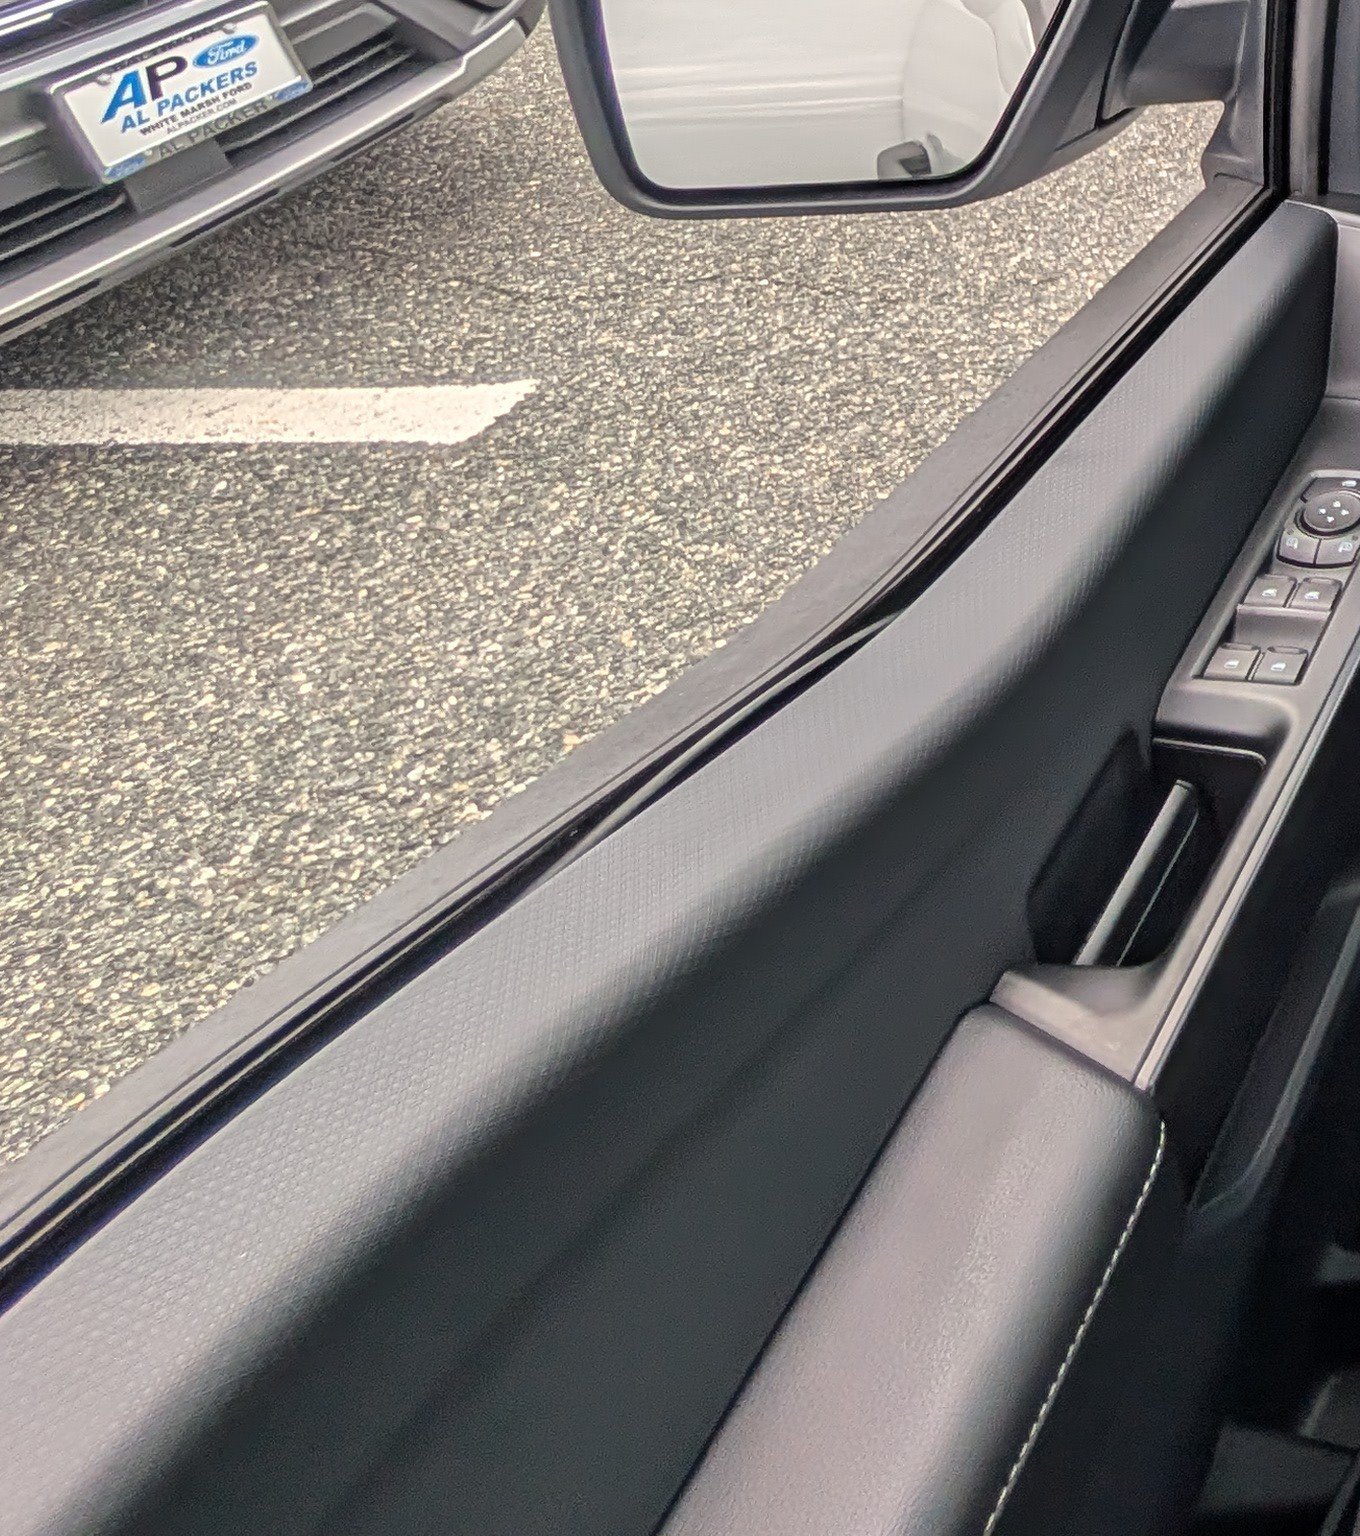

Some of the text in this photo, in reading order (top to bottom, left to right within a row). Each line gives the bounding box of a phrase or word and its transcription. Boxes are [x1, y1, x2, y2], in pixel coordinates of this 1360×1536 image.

[207, 38, 247, 64] Ford
[101, 55, 189, 125] AP
[121, 109, 151, 134] AL
[156, 61, 259, 117] PACKERS
[139, 115, 178, 136] WHITE
[180, 96, 221, 119] MARSH
[222, 82, 253, 100] FORD
